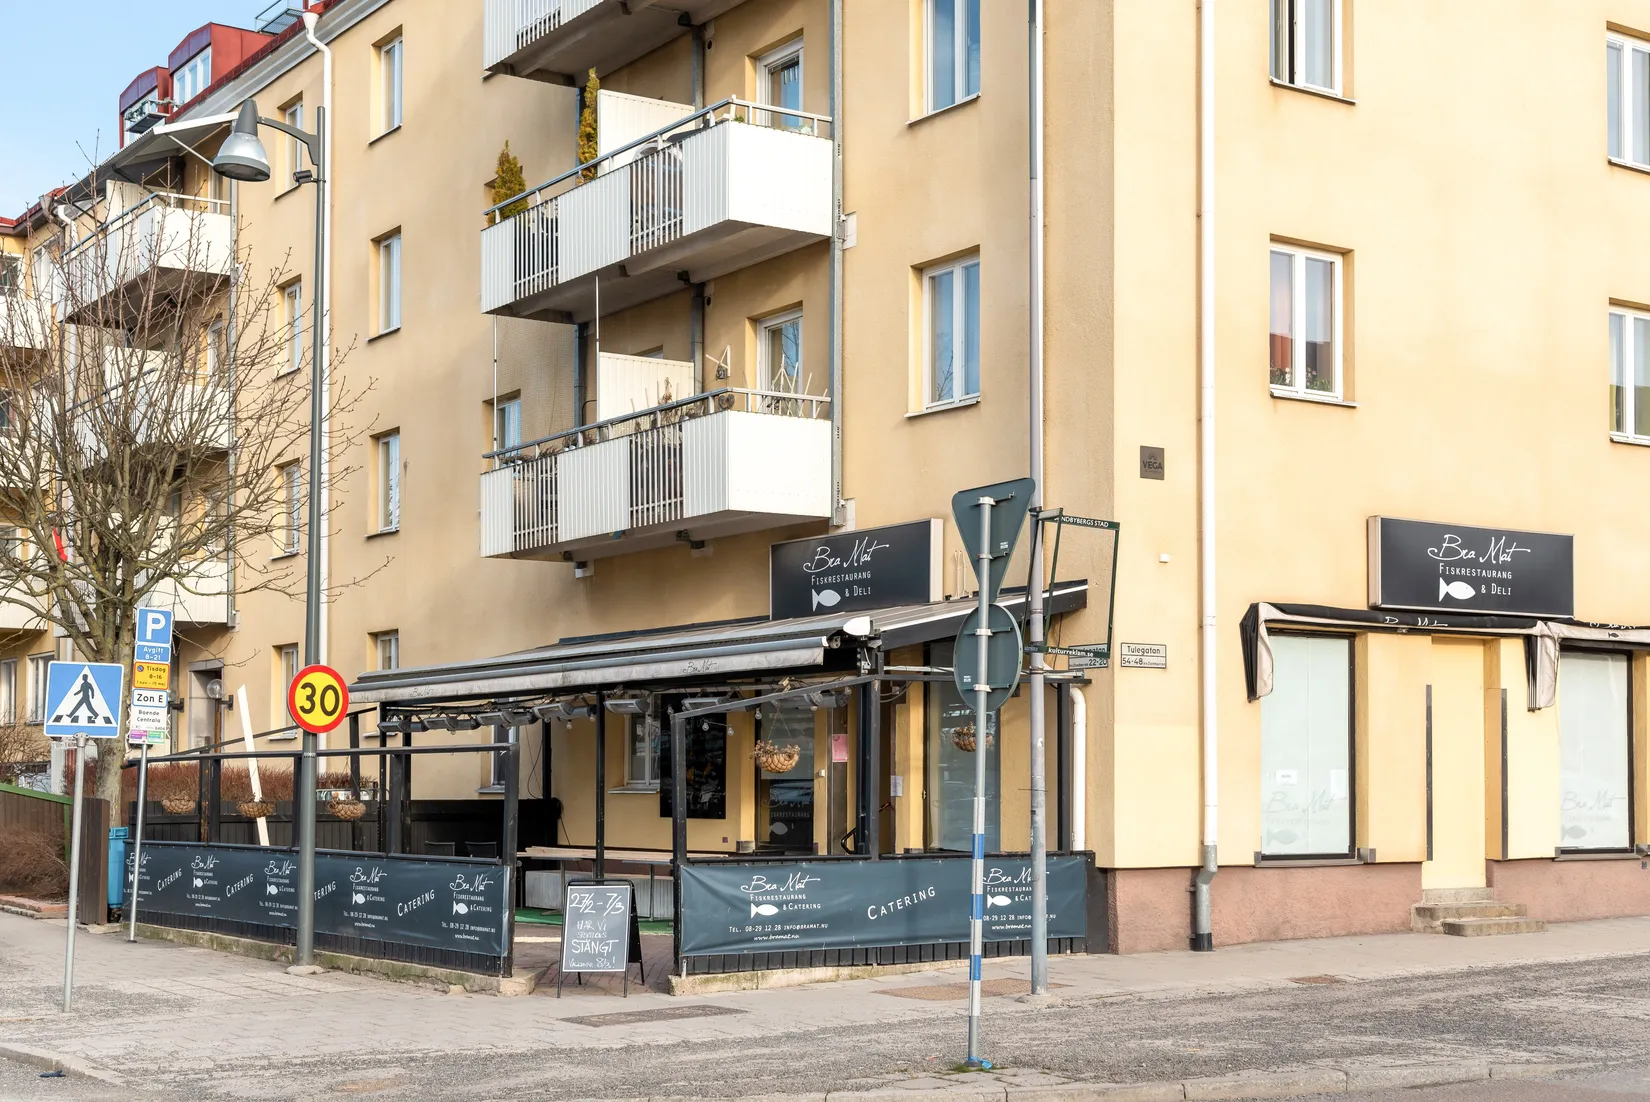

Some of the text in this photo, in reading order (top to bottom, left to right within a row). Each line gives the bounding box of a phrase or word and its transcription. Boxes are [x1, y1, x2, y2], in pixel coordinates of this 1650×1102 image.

[1142, 460, 1163, 470] VEGA
[1054, 516, 1094, 526] NDBYBERGS
[802, 536, 890, 573] Bra Mat
[1428, 534, 1530, 564] Bra Mat
[845, 587, 850, 597] &
[1481, 585, 1486, 594] &
[146, 612, 166, 640] P
[1048, 648, 1094, 657] kulturreklam.se
[1127, 646, 1160, 656] Tulegatan
[137, 694, 163, 703] Zon E
[300, 682, 340, 716] 30
[450, 874, 494, 892] Bra Mat
[740, 872, 821, 893] Bra Mat
[983, 868, 1012, 884] Bra
[226, 874, 254, 897] CATERING
[314, 881, 336, 900] TERING
[398, 890, 435, 916] CATERING
[570, 893, 596, 913] 27/2
[603, 893, 624, 916] 7/3
[867, 886, 936, 920] CATERING
[572, 939, 619, 956] STÄNGT
